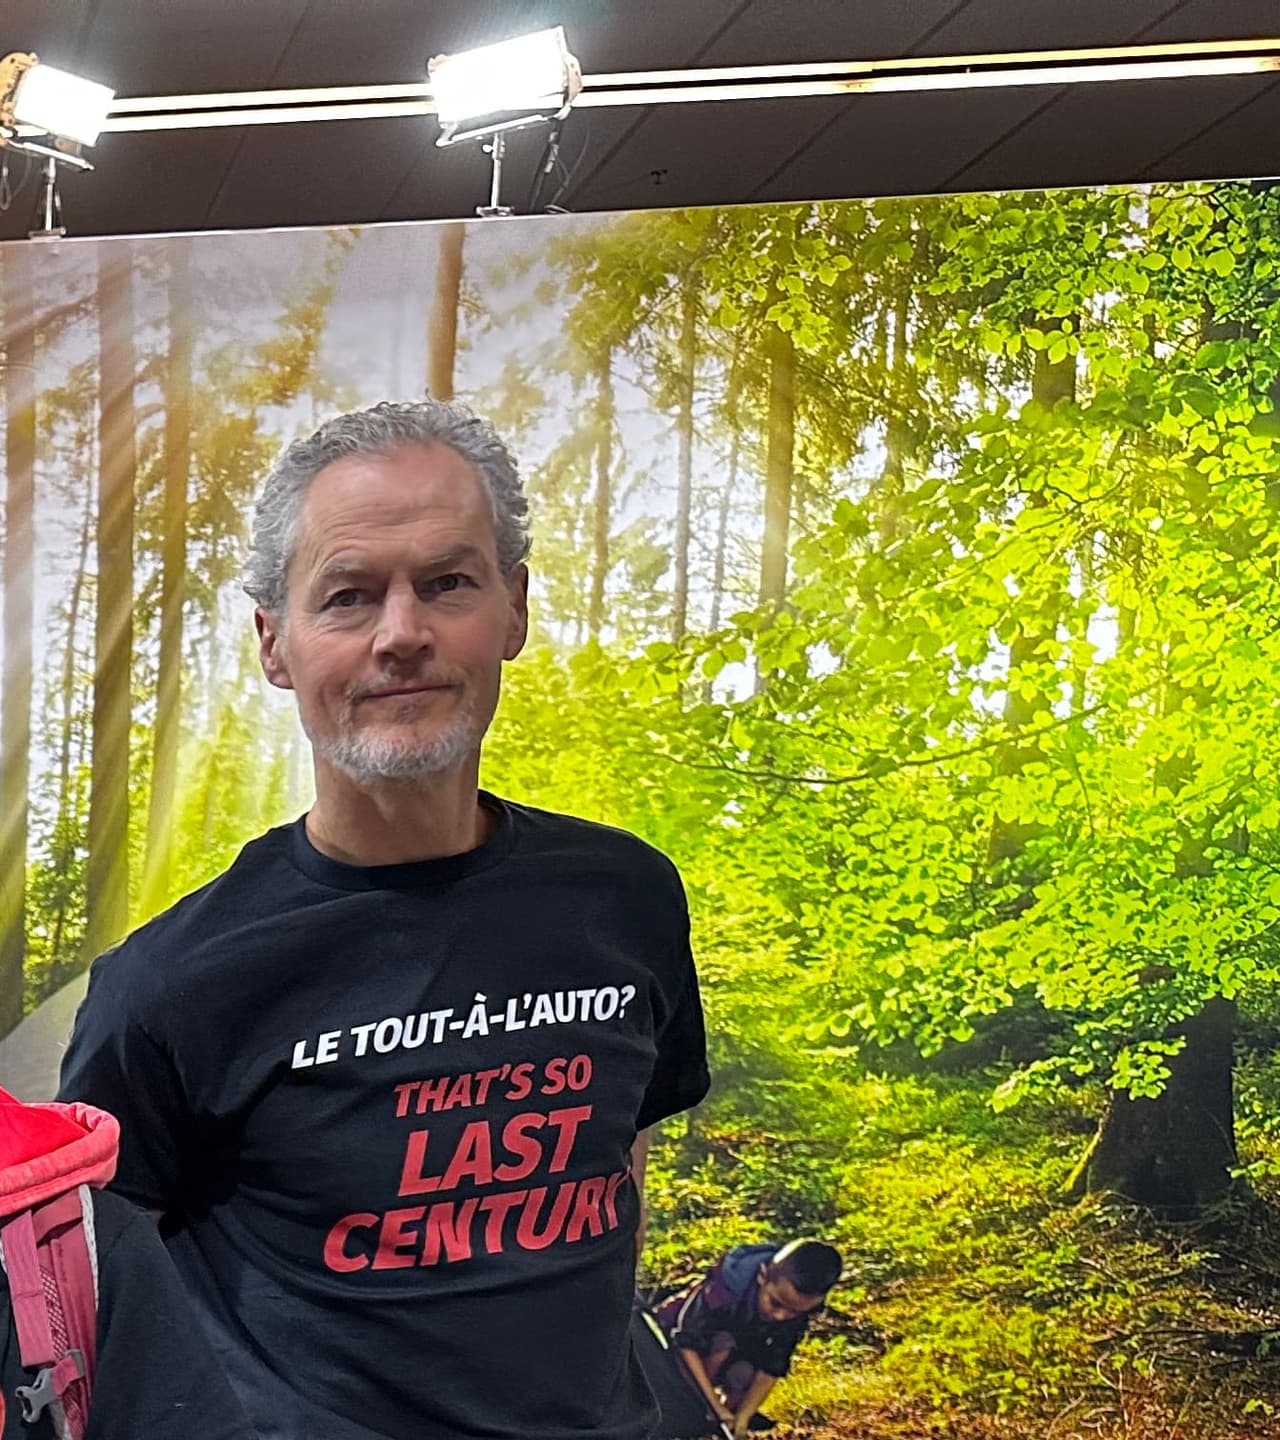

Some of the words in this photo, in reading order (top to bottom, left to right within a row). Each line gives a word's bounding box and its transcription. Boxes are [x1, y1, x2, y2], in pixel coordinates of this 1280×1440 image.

[291, 1030, 343, 1069] LE
[349, 984, 637, 1058] TOUT-À-L'AUTO?
[394, 1062, 535, 1118] THAT'S
[541, 1054, 593, 1095] SO
[397, 1104, 593, 1198] LAST
